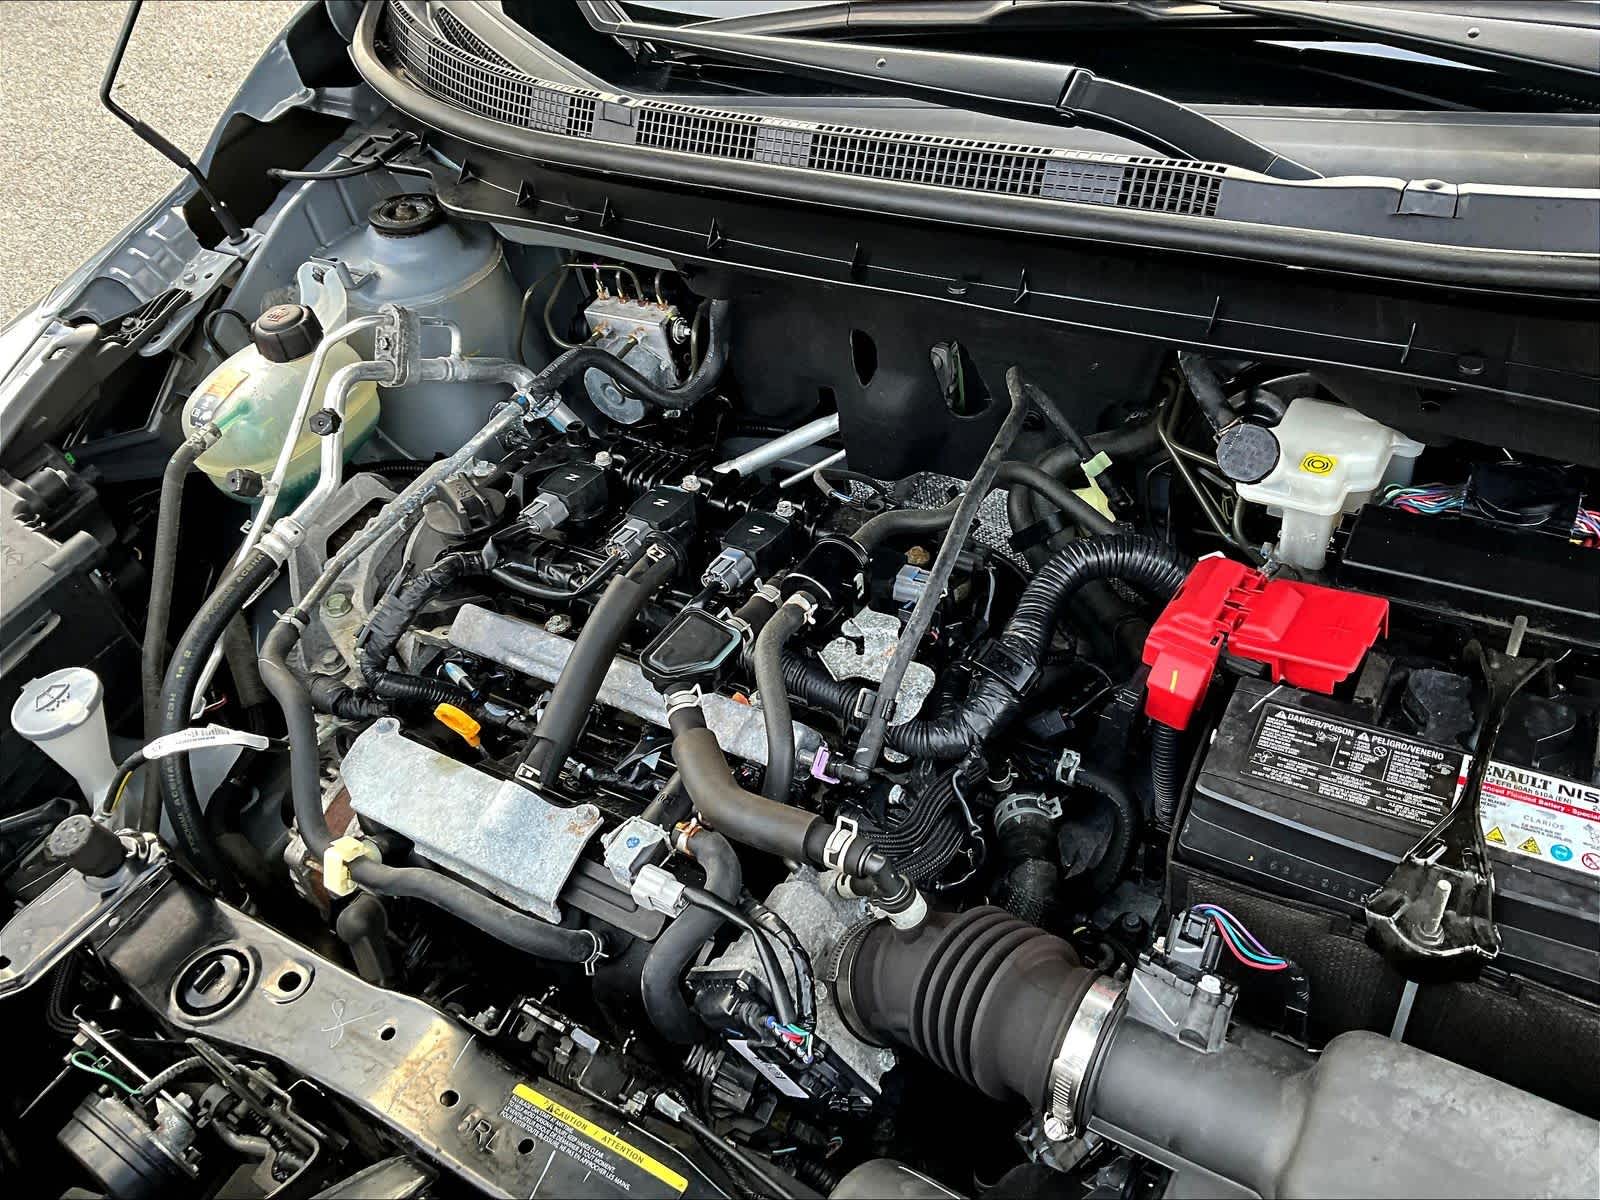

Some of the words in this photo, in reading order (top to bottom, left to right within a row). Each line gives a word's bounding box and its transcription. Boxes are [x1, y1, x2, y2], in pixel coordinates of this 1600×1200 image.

[1287, 713, 1354, 737] DANGER/POISON
[1371, 735, 1444, 760] PELIGRO/VENENO
[1469, 760, 1552, 791] NAULT
[1523, 814, 1566, 831] CLARIOS
[553, 1107, 588, 1131] CAUTION
[600, 1134, 645, 1165] ATTENTION
